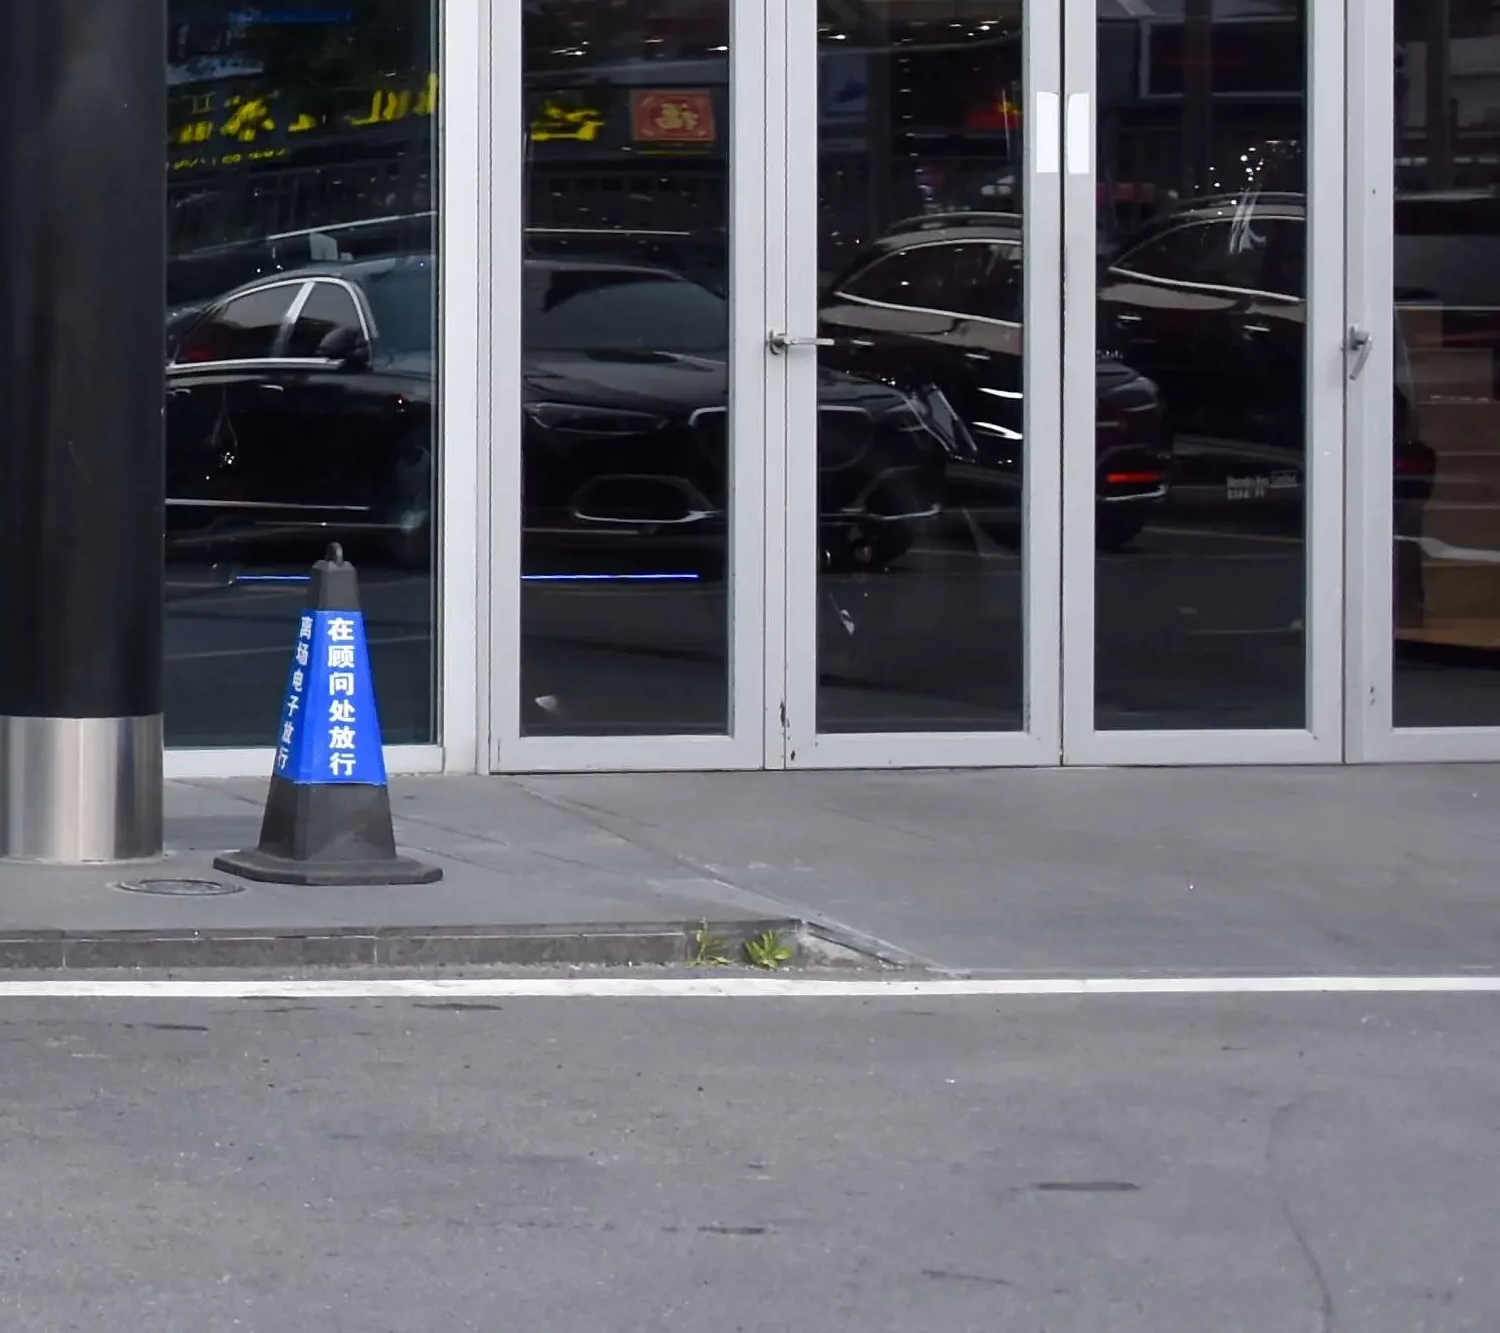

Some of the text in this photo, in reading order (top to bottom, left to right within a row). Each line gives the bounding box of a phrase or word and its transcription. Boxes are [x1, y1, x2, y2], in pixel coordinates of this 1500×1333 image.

[327, 617, 356, 776] 在顾问处放行
